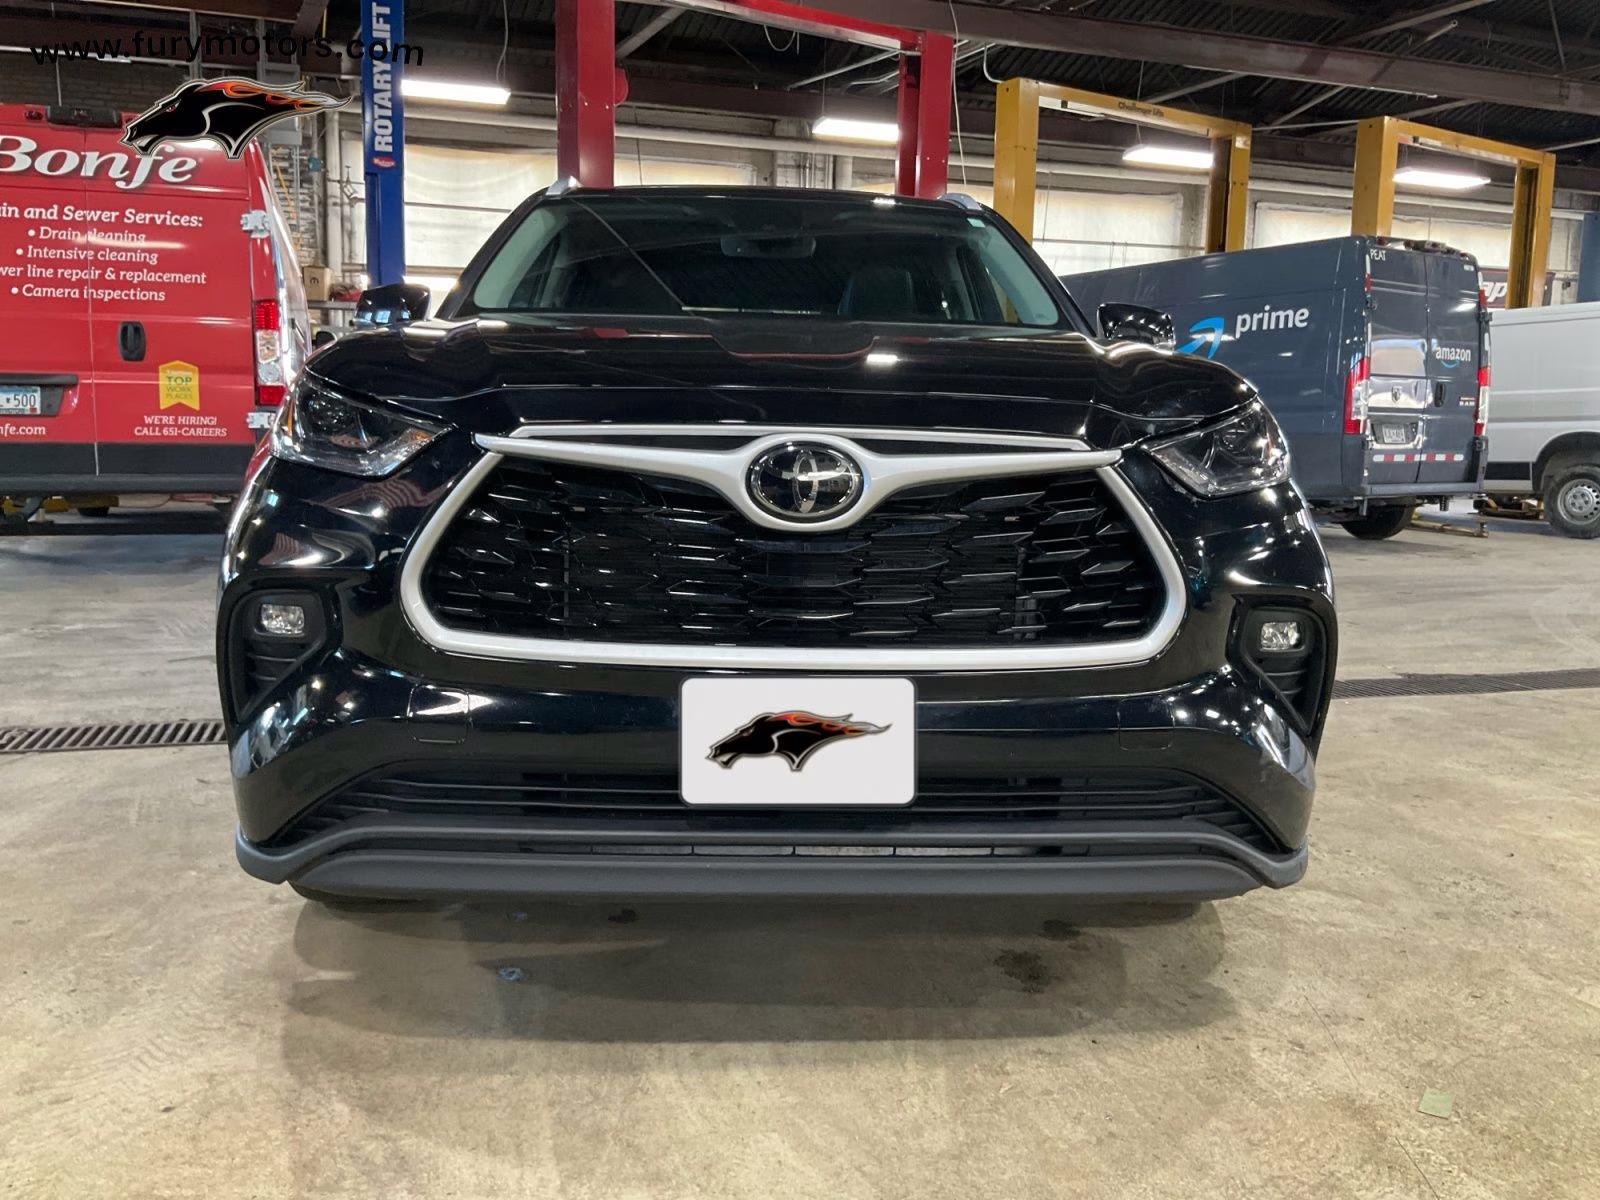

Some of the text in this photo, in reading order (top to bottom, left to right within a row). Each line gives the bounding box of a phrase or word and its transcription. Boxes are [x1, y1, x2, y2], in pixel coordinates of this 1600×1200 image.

[372, 2, 391, 52] LIFT
[373, 59, 393, 152] ROTARY
[0, 135, 197, 189] Bonfe
[23, 204, 59, 220] and
[62, 206, 119, 222] Sewer
[123, 208, 203, 227] Services:
[39, 226, 81, 240] Drain
[27, 245, 158, 265] Intensive cleaning
[27, 264, 54, 278] line
[57, 266, 102, 281] repair
[104, 267, 116, 280] &
[119, 268, 207, 284] replacement
[22, 283, 166, 302] Camera inspections
[1235, 304, 1310, 339] prime
[1435, 346, 1471, 362] amazon
[166, 376, 193, 386] TOP
[178, 415, 218, 426] HIRING!
[134, 426, 228, 437] CALL 651-CAREERS
